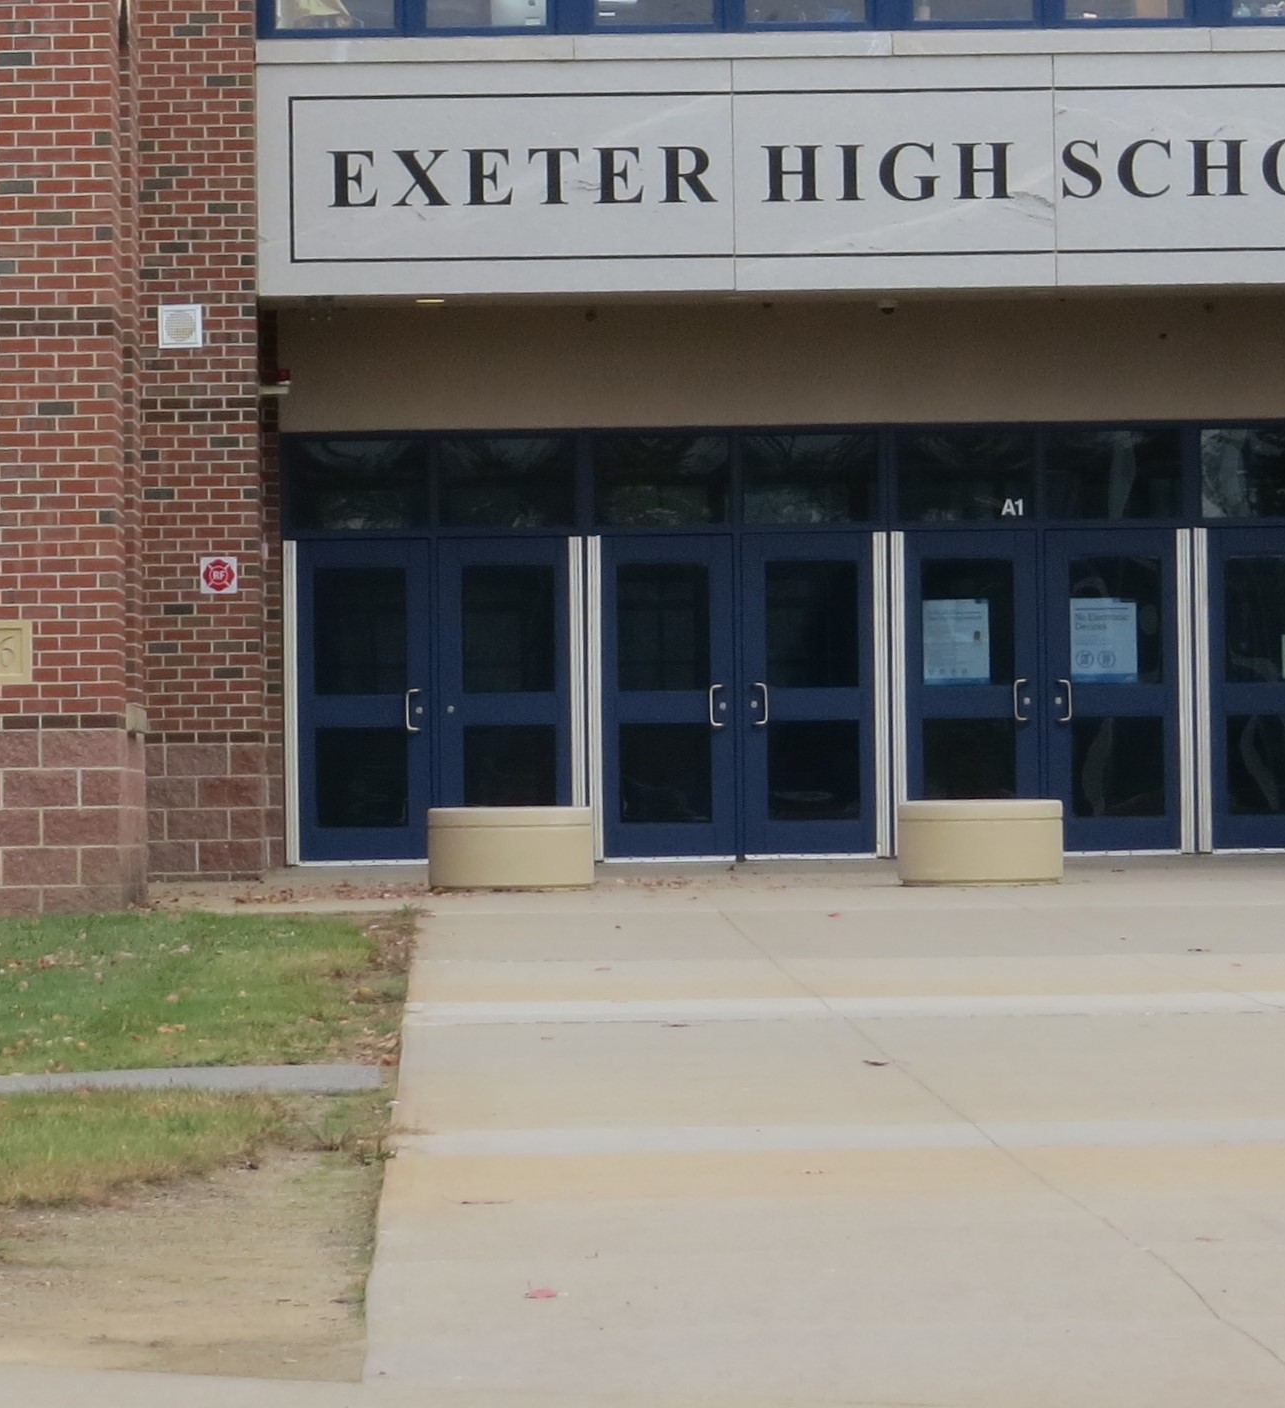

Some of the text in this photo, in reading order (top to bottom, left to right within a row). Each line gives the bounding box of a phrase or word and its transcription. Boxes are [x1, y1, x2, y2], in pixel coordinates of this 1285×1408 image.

[326, 146, 719, 209] EXETER
[760, 141, 1014, 204] HIGH
[1001, 497, 1024, 517] A1
[212, 570, 226, 581] RF
